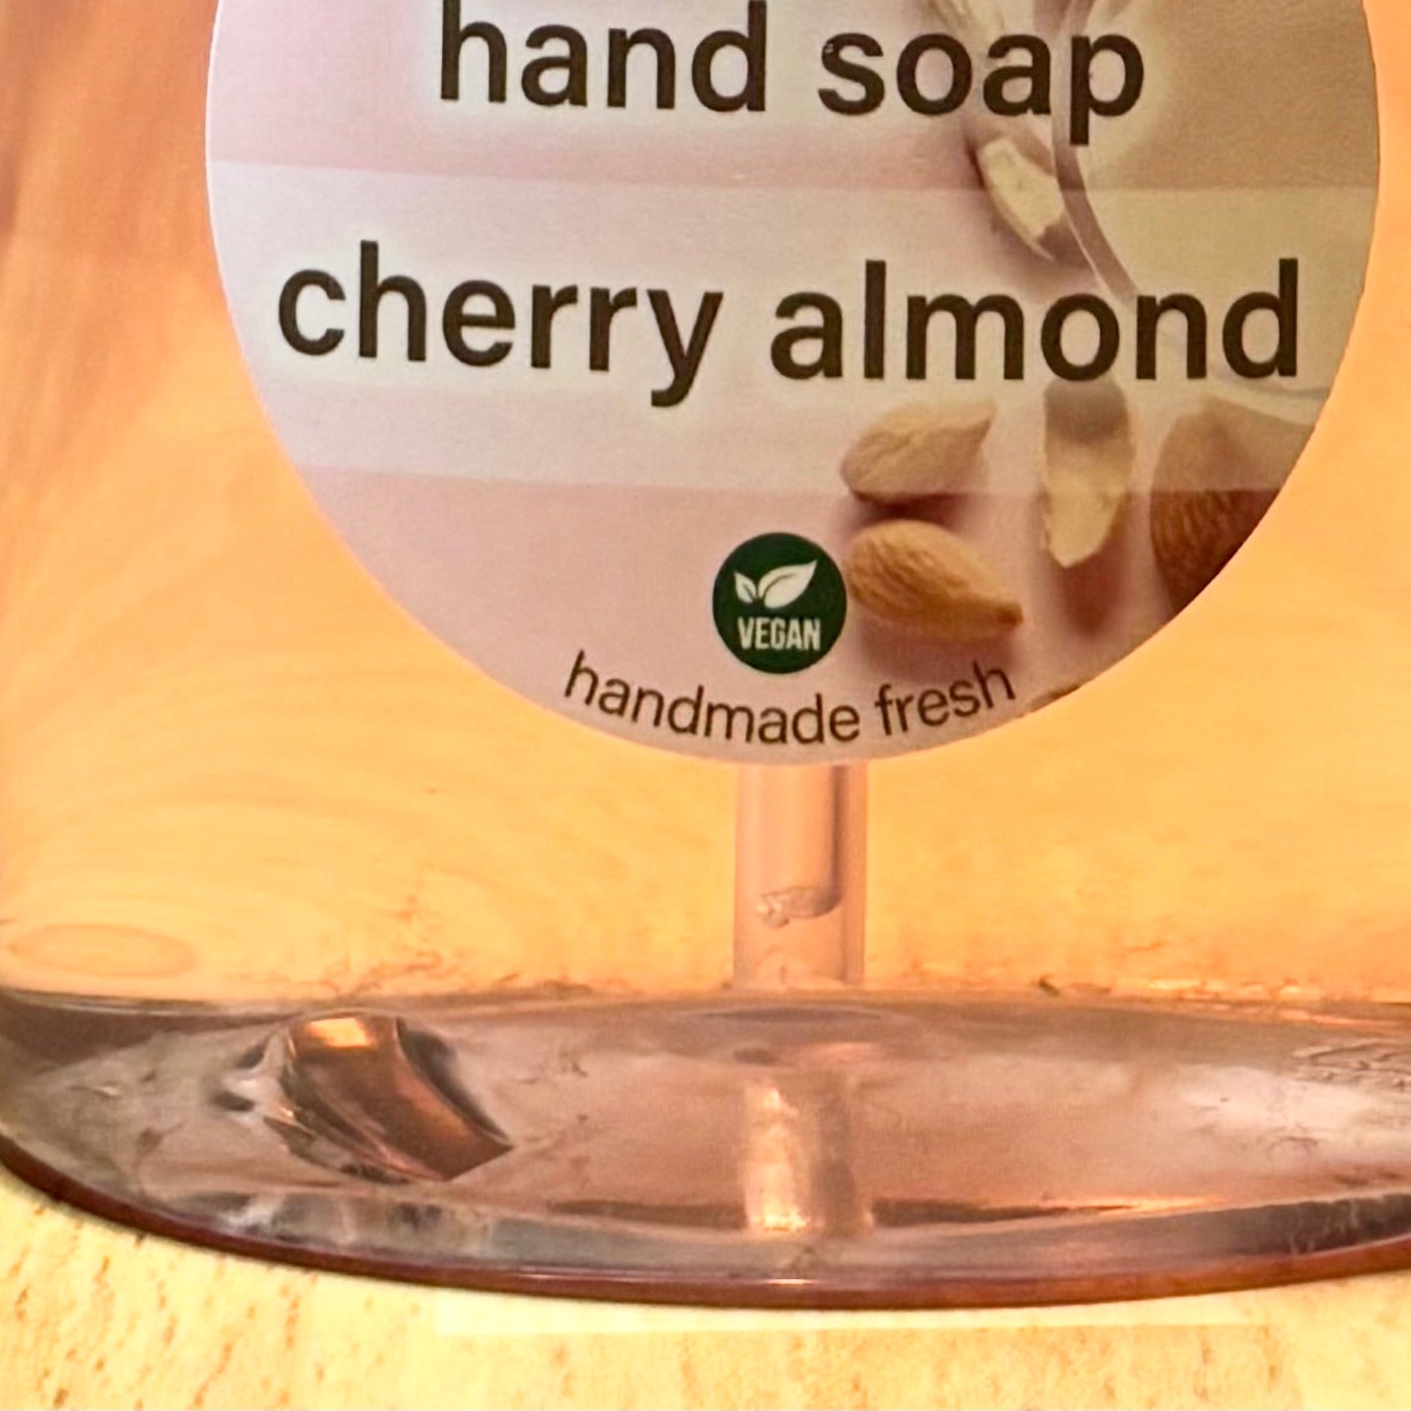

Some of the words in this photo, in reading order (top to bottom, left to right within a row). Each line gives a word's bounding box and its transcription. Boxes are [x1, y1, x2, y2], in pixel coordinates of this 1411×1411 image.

[818, 32, 1145, 146] soap
[278, 240, 724, 408] cherry
[770, 258, 1299, 383] almond
[737, 616, 822, 653] VEGAN
[564, 649, 861, 746] handmade
[874, 660, 1017, 737] fresh
